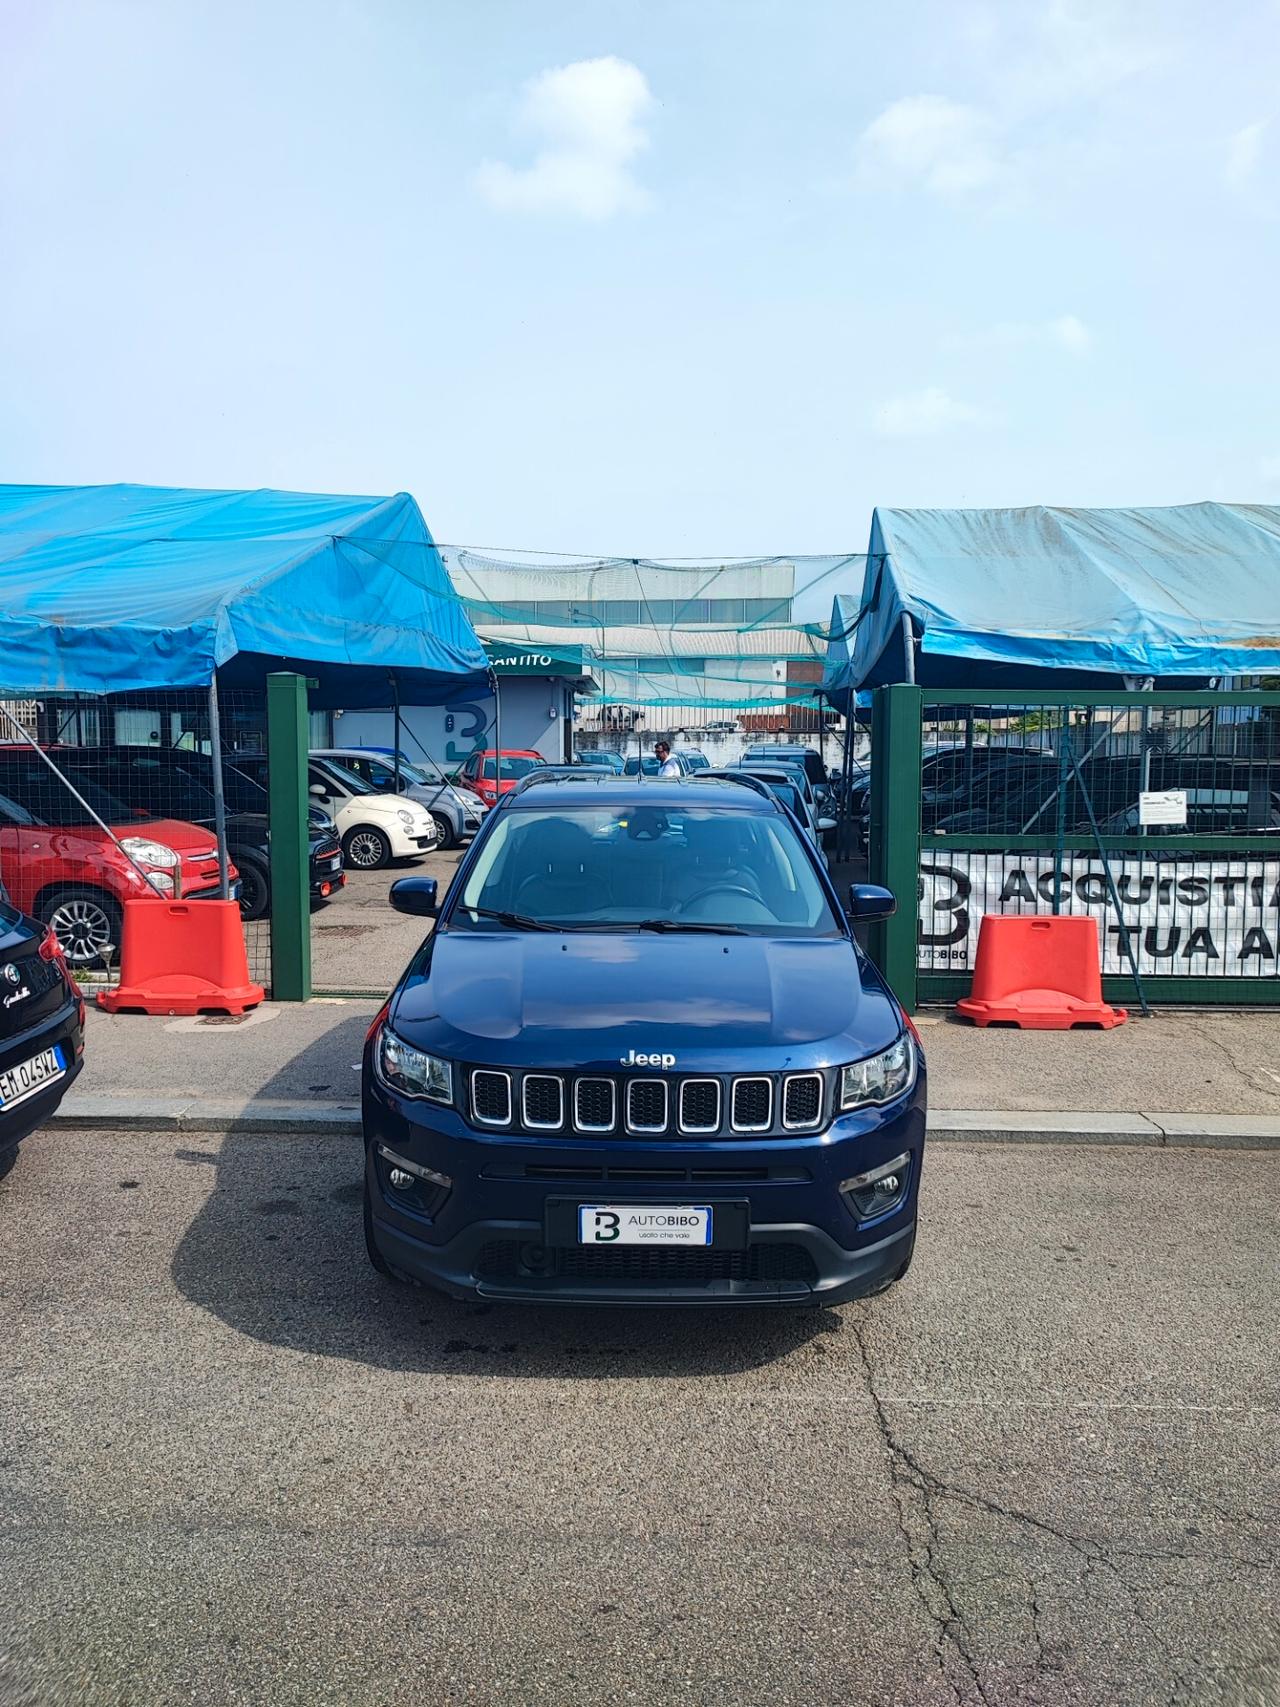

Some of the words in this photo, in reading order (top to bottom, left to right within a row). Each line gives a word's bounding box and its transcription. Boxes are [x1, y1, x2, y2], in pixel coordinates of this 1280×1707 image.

[1108, 925, 1220, 958] TUA
[1237, 926, 1280, 959] A
[620, 1049, 676, 1070] Jeep
[628, 1215, 700, 1226] AUTOBIBO
[660, 1231, 674, 1239] che
[675, 1231, 690, 1239] vale
